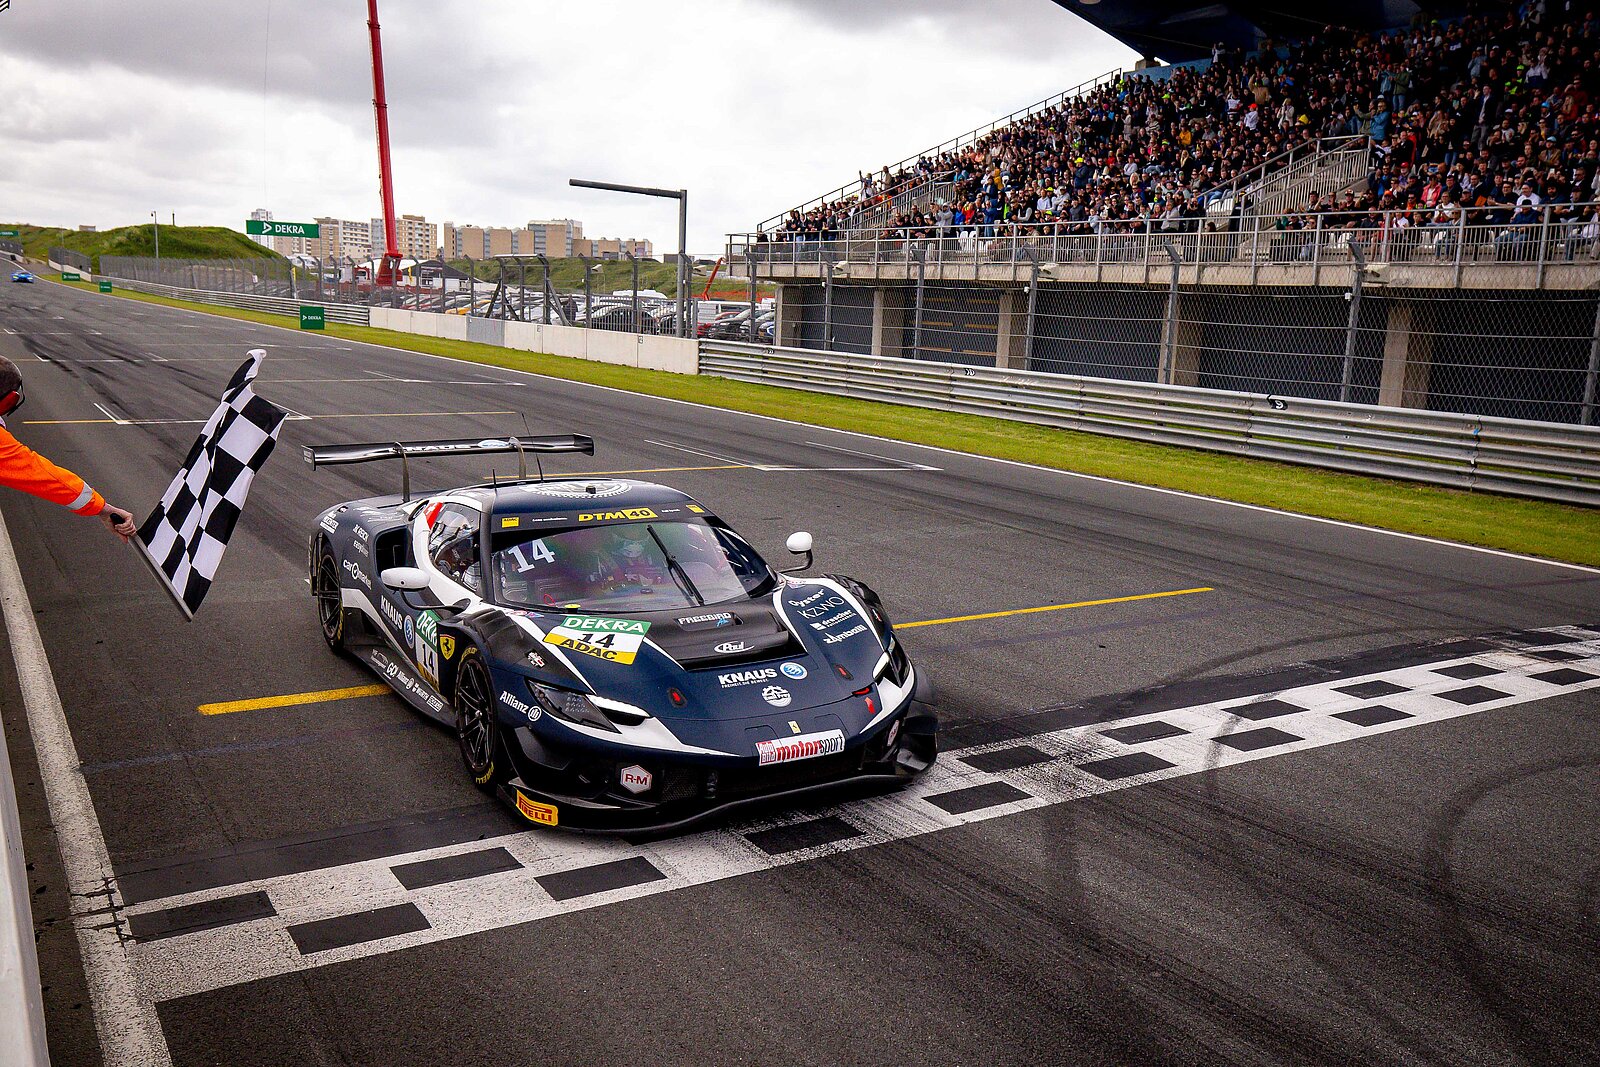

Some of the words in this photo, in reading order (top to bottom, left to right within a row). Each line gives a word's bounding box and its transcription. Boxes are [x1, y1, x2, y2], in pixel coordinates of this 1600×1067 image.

[275, 224, 305, 235] DEKRA
[1275, 399, 1284, 410] 9
[578, 512, 626, 522] DTM
[629, 509, 651, 518] 40
[507, 538, 556, 573] 14
[788, 588, 824, 607] Oyster
[380, 595, 403, 630] KNAUS
[678, 612, 732, 625] FREEBIRD
[563, 617, 645, 633] DEKRA
[561, 638, 618, 660] ADAC
[577, 633, 616, 648] 14
[722, 641, 745, 652] Paul
[422, 643, 435, 675] 14
[718, 668, 778, 685] KNAUS
[499, 691, 530, 714] Allianz
[776, 734, 843, 761] motorsport
[625, 772, 649, 785] R-M
[518, 796, 552, 822] PIRELLI
